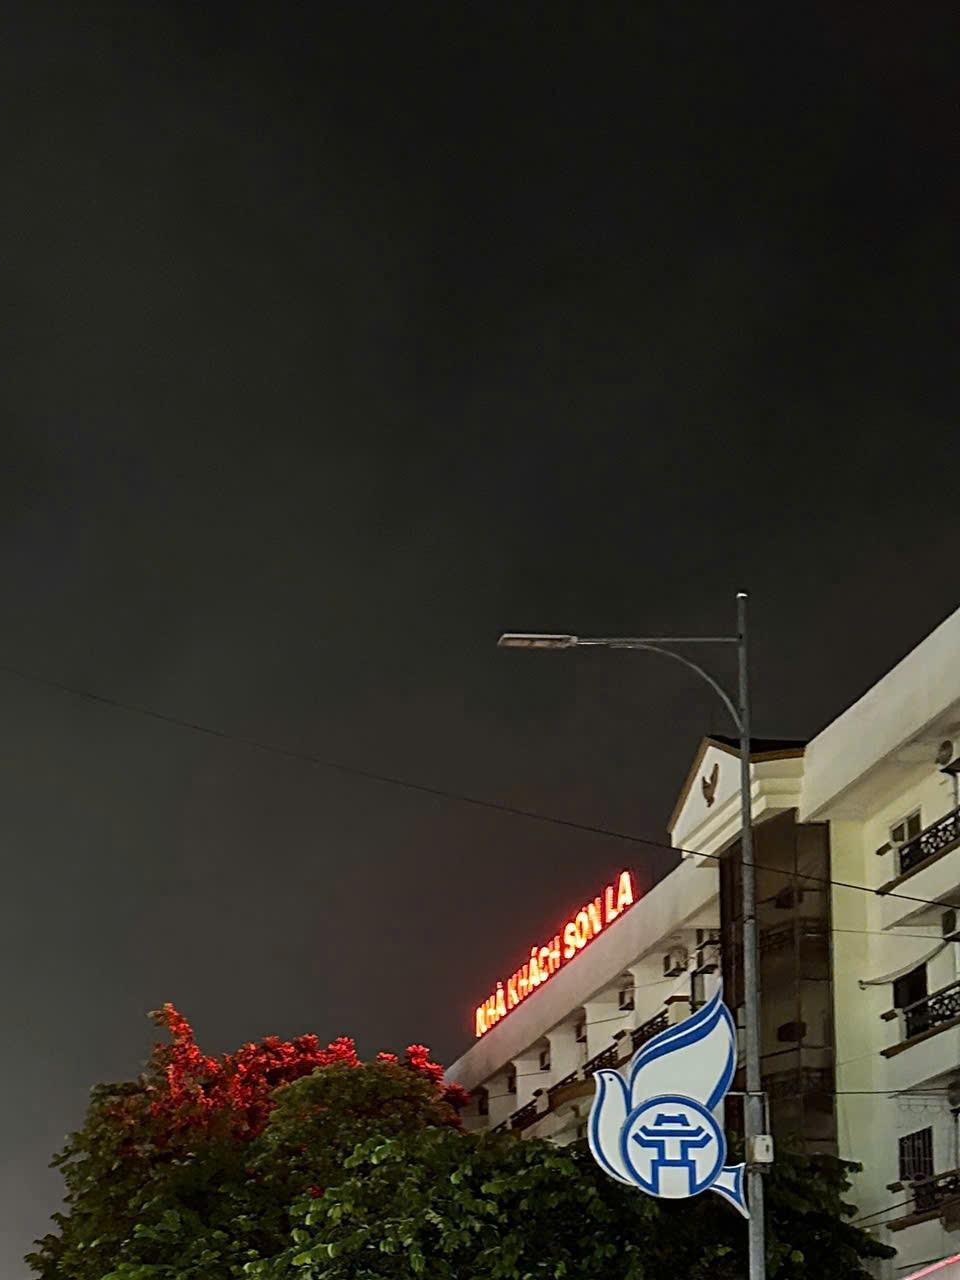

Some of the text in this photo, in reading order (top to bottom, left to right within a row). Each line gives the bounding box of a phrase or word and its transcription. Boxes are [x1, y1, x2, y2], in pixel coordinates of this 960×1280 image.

[475, 981, 508, 1038] NHÀ
[507, 935, 561, 1010] KHÁCH
[604, 870, 634, 924] LA
